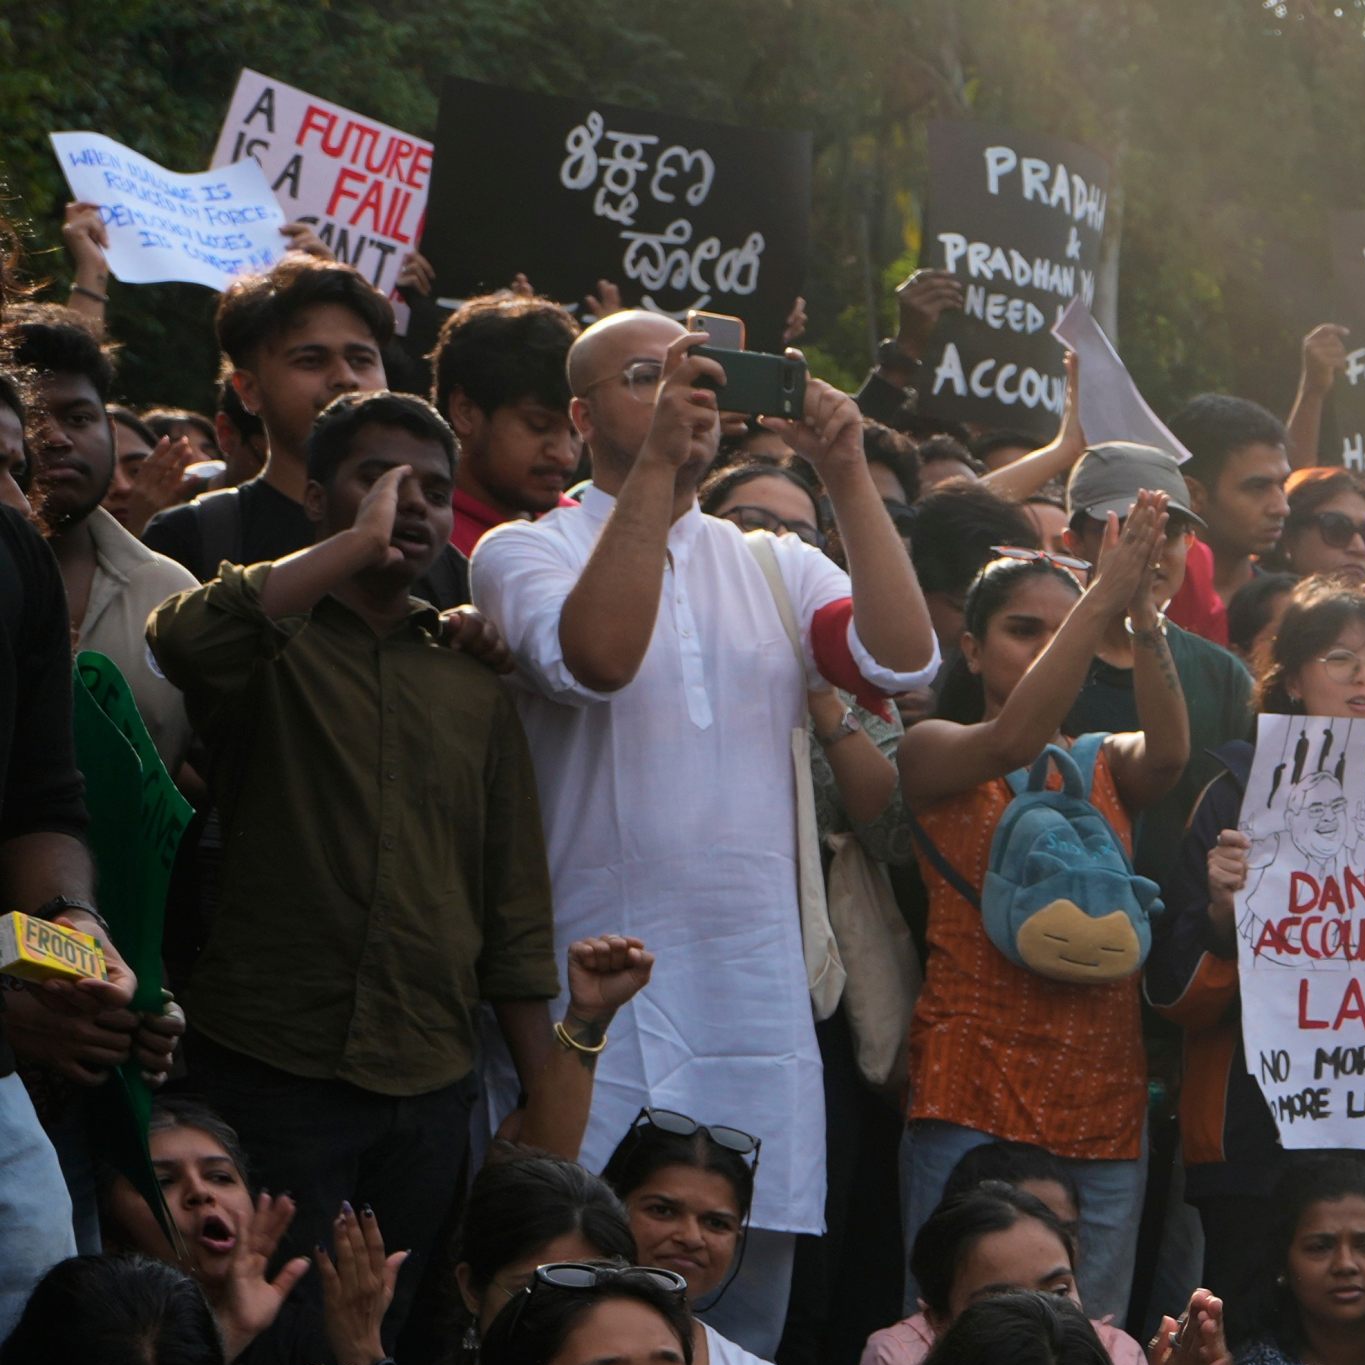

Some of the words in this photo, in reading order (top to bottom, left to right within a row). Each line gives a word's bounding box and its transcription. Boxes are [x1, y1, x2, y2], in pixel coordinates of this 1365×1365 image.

[244, 87, 275, 133] A
[295, 104, 432, 190] FUTURE
[201, 183, 232, 201] IS
[271, 153, 303, 199] A
[326, 166, 414, 245] FAIL
[937, 232, 1075, 299] PRADHAN
[1066, 226, 1081, 260] &
[964, 284, 1045, 334] NEED
[26, 920, 96, 975] FROOTI
[1260, 1049, 1290, 1084] NO
[1278, 1086, 1333, 1124] MORE
